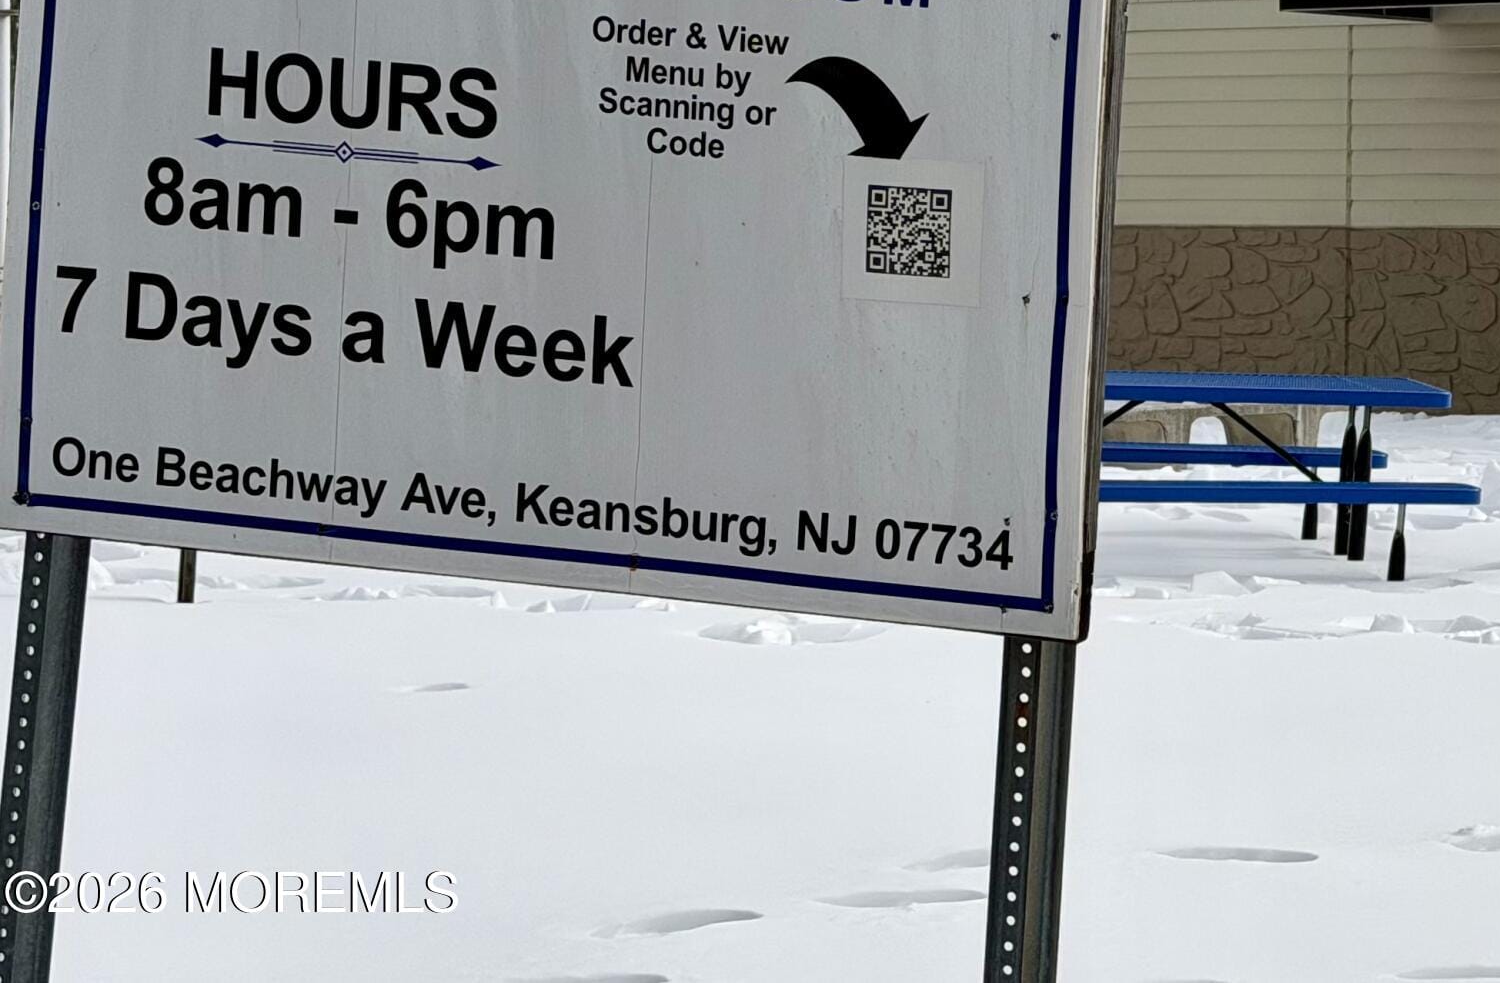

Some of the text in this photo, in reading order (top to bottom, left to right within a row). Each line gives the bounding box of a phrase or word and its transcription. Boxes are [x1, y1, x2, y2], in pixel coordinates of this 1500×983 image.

[592, 15, 790, 56] Order & View
[207, 46, 498, 139] HOURS
[598, 87, 778, 130] Scanning or
[625, 55, 752, 98] Menu by
[646, 127, 725, 159] Code
[144, 156, 555, 270] 8am - 6pm
[56, 264, 635, 388] 7 Days a Week
[52, 436, 1014, 571] One Beachway Ave, Keansburg, NJ 07734
